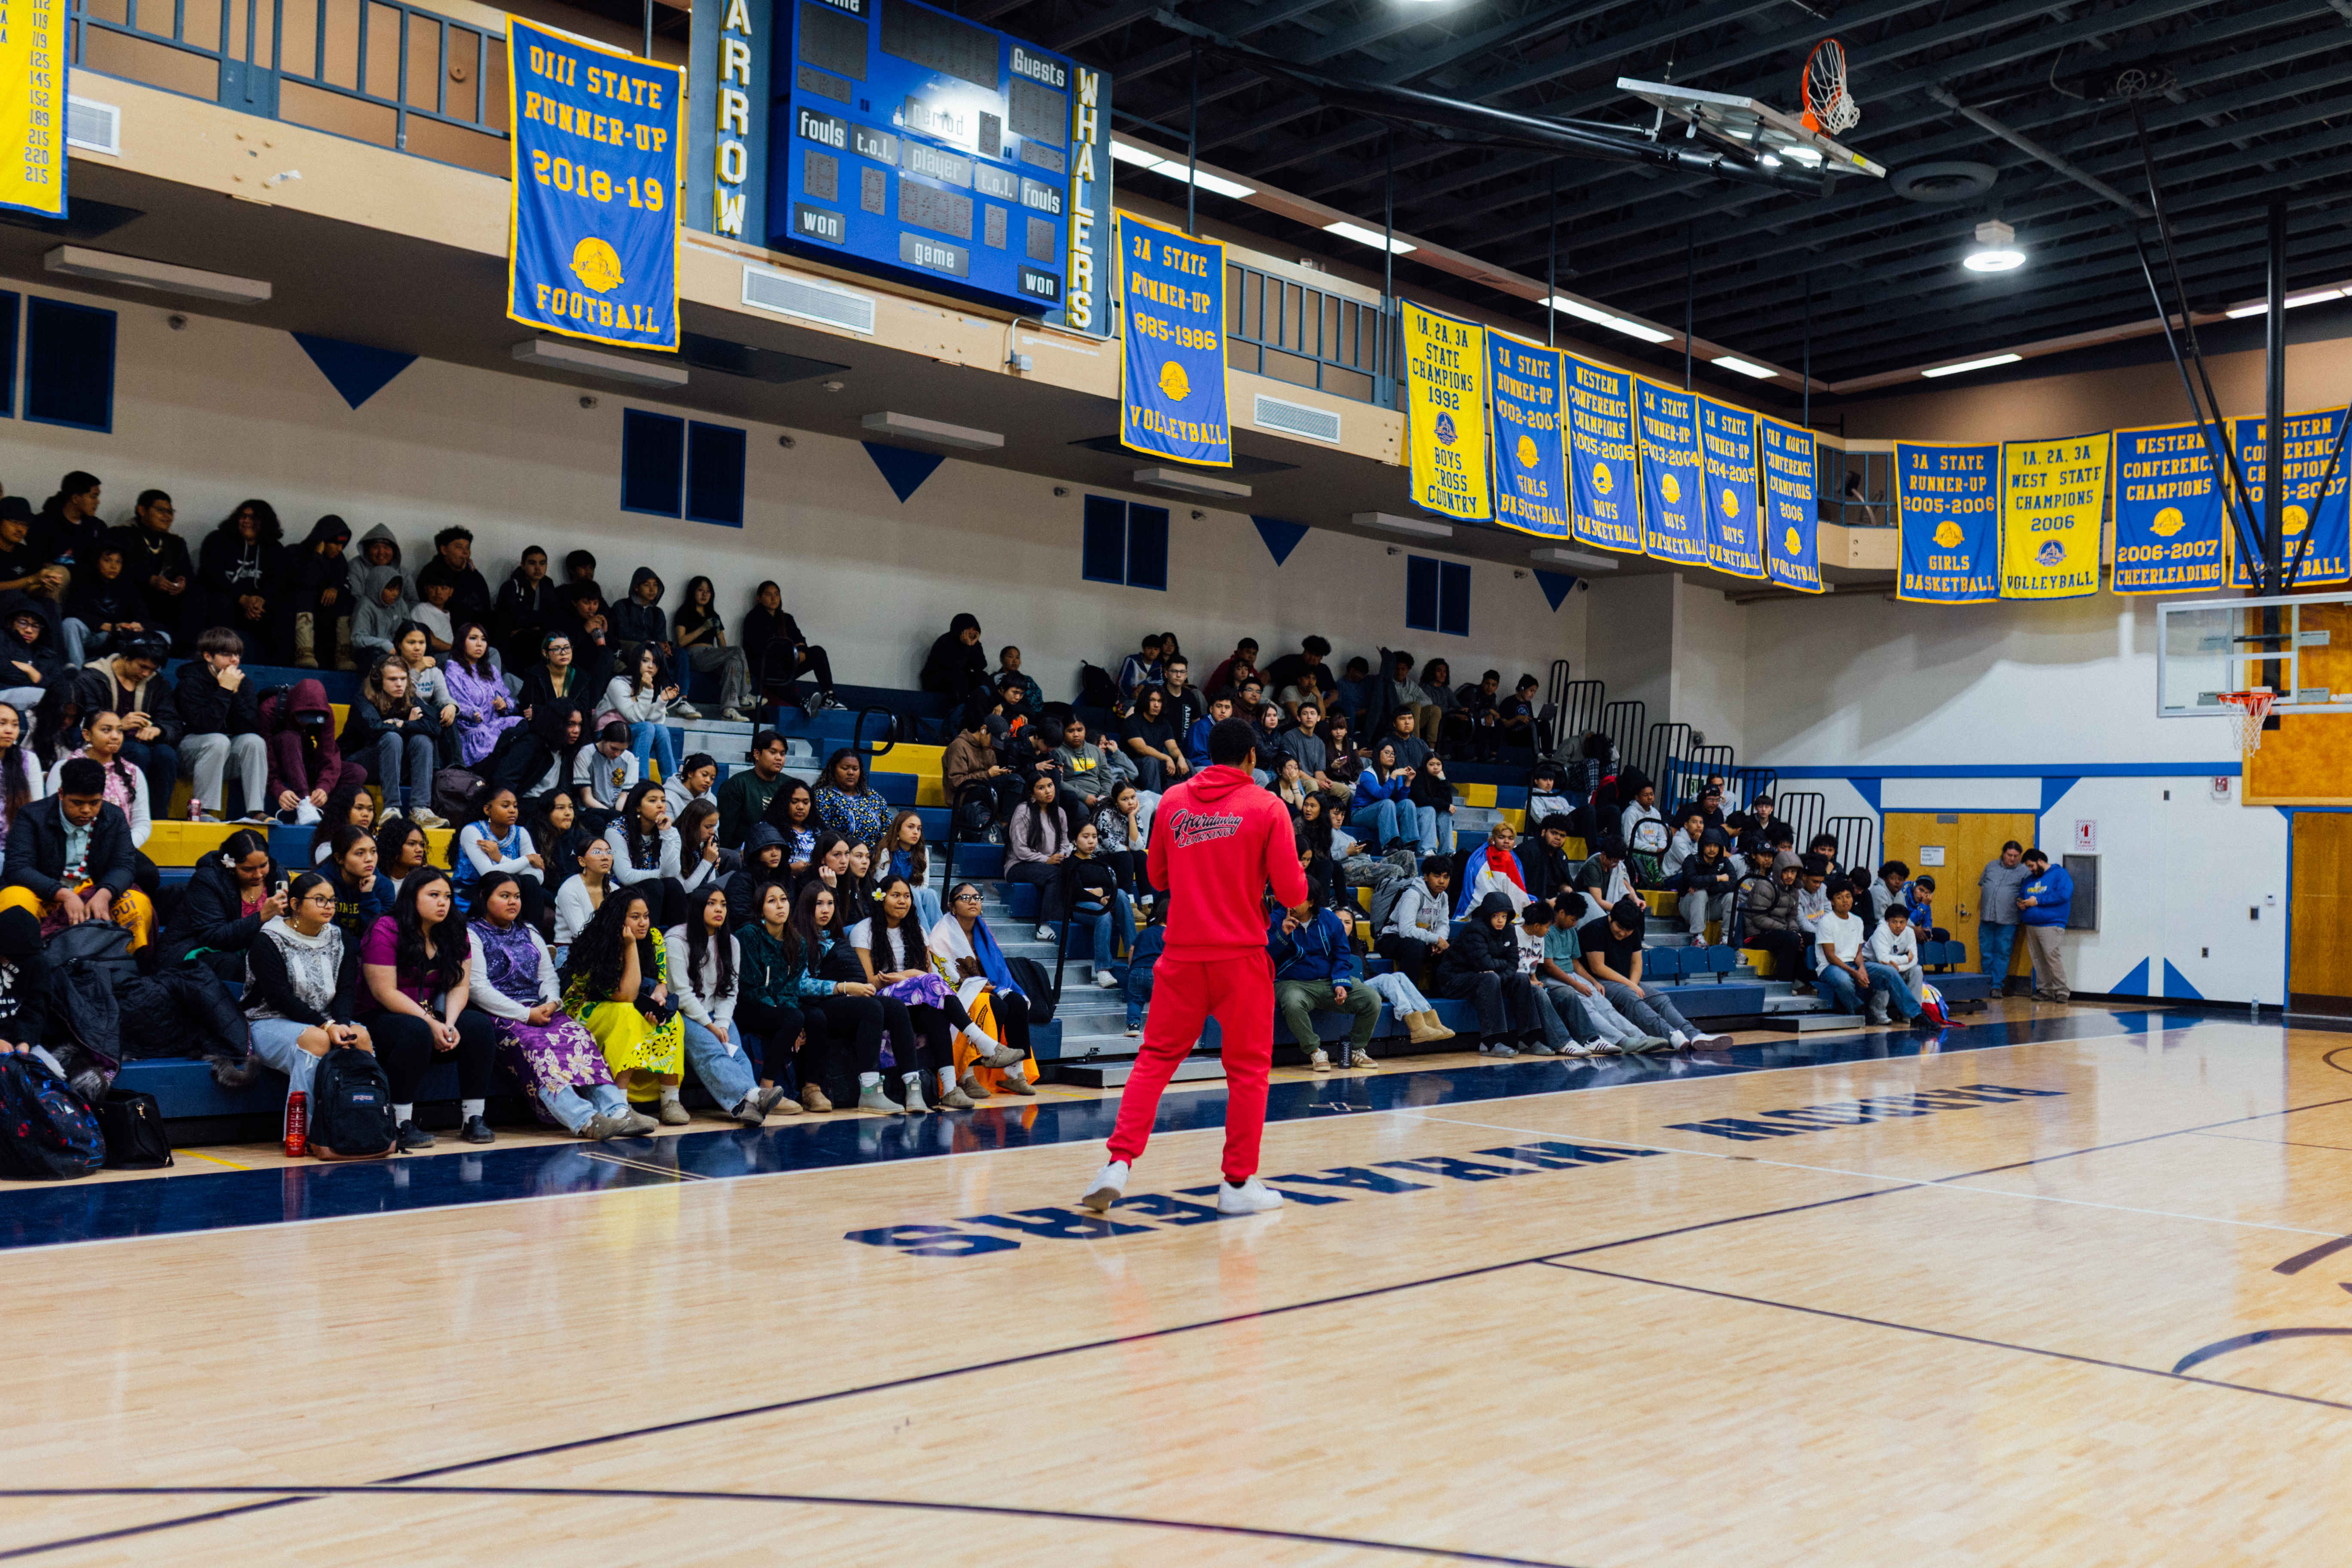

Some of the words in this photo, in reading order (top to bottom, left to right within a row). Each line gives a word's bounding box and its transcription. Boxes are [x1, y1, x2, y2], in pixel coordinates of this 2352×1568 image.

[33, 12, 48, 30] 119
[32, 30, 47, 49] 119
[30, 50, 49, 70] 125
[1013, 47, 1066, 88] Guests
[30, 70, 51, 89] 145
[530, 45, 576, 86] DIII
[588, 67, 662, 110] STATE
[30, 89, 49, 108] 152
[30, 108, 49, 127] 189
[525, 91, 668, 152] RUNNER-UP
[28, 128, 49, 147] 215
[24, 146, 49, 165] 220
[913, 148, 962, 180] player
[25, 165, 48, 184] 215
[533, 149, 664, 212] 2018-19
[1068, 67, 1099, 328] WHALERS
[803, 211, 838, 237] won
[915, 242, 955, 268] game
[1133, 236, 1151, 261] 3A
[1163, 245, 1207, 277] STATE
[1026, 273, 1054, 296] won
[1131, 271, 1210, 314] RUNNER-UP
[536, 283, 660, 333] FOOTBALL
[1455, 328, 1468, 348] 3A
[1426, 343, 1460, 370] STATE
[1498, 346, 1510, 368] 3A
[1518, 355, 1551, 379] STATE
[1412, 358, 1473, 392] CHAMPIONS
[1576, 366, 1618, 395] WESTERN
[1428, 388, 1460, 411] 1992
[1498, 372, 1553, 405] RUNNER-UP
[1569, 385, 1627, 419] CONFERENCE
[1644, 391, 1654, 411] 3A
[1662, 398, 1688, 419] STATE
[1130, 405, 1227, 445] VOLLEYBALL
[1574, 410, 1625, 439] CHAMPIONS
[1643, 416, 1690, 444] RUNNER-UP
[1706, 409, 1715, 428] 3A
[1722, 416, 1747, 437] STATE
[2257, 417, 2332, 441] WSTERN
[1705, 432, 1749, 460] RUNNER-UP
[1767, 428, 1780, 448] FAR
[1786, 434, 1810, 456] NORTH
[2074, 445, 2091, 461] 3A
[2136, 432, 2206, 454] WESTERN
[2243, 437, 2345, 462] COERENC
[1435, 447, 1462, 470] BOYS
[1705, 456, 1755, 484] 004-2005
[1766, 450, 1812, 478] CONFERENCE
[1912, 454, 1929, 469] 3A
[1940, 455, 1984, 470] STATE
[2248, 458, 2340, 482] CHMPIONS
[1434, 468, 1467, 492] CROSS
[1517, 474, 1548, 498] GIRLS
[1770, 474, 1812, 500] CHAMPIONS
[1909, 475, 1987, 492] RUNNER-UP
[2012, 473, 2047, 488] WEST
[2059, 466, 2101, 485] STATE
[1428, 485, 1477, 514] COUNTRY
[2016, 490, 2094, 510] CHAMPIONS
[2127, 478, 2212, 501] CHAMPIONS
[1593, 499, 1618, 520] BOYS
[1780, 502, 1804, 522] 2006
[1903, 496, 1995, 514] 2005-2006
[1578, 514, 1638, 544] BASKETBALL
[1663, 511, 1686, 531] BOYS
[2030, 514, 2075, 532] 2006
[1649, 531, 1706, 556] BASKETBALL
[1722, 525, 1744, 545] BOYS
[1929, 555, 1970, 571] GIRLS
[2118, 540, 2218, 563] 2006-2007
[1905, 574, 1995, 592] BASKETBALL
[2007, 572, 2093, 590] VOLLEYBALL
[2117, 564, 2220, 585] CHEERLEADING
[1170, 808, 1243, 837] Hardaway
[1178, 827, 1230, 848] LEARNING
